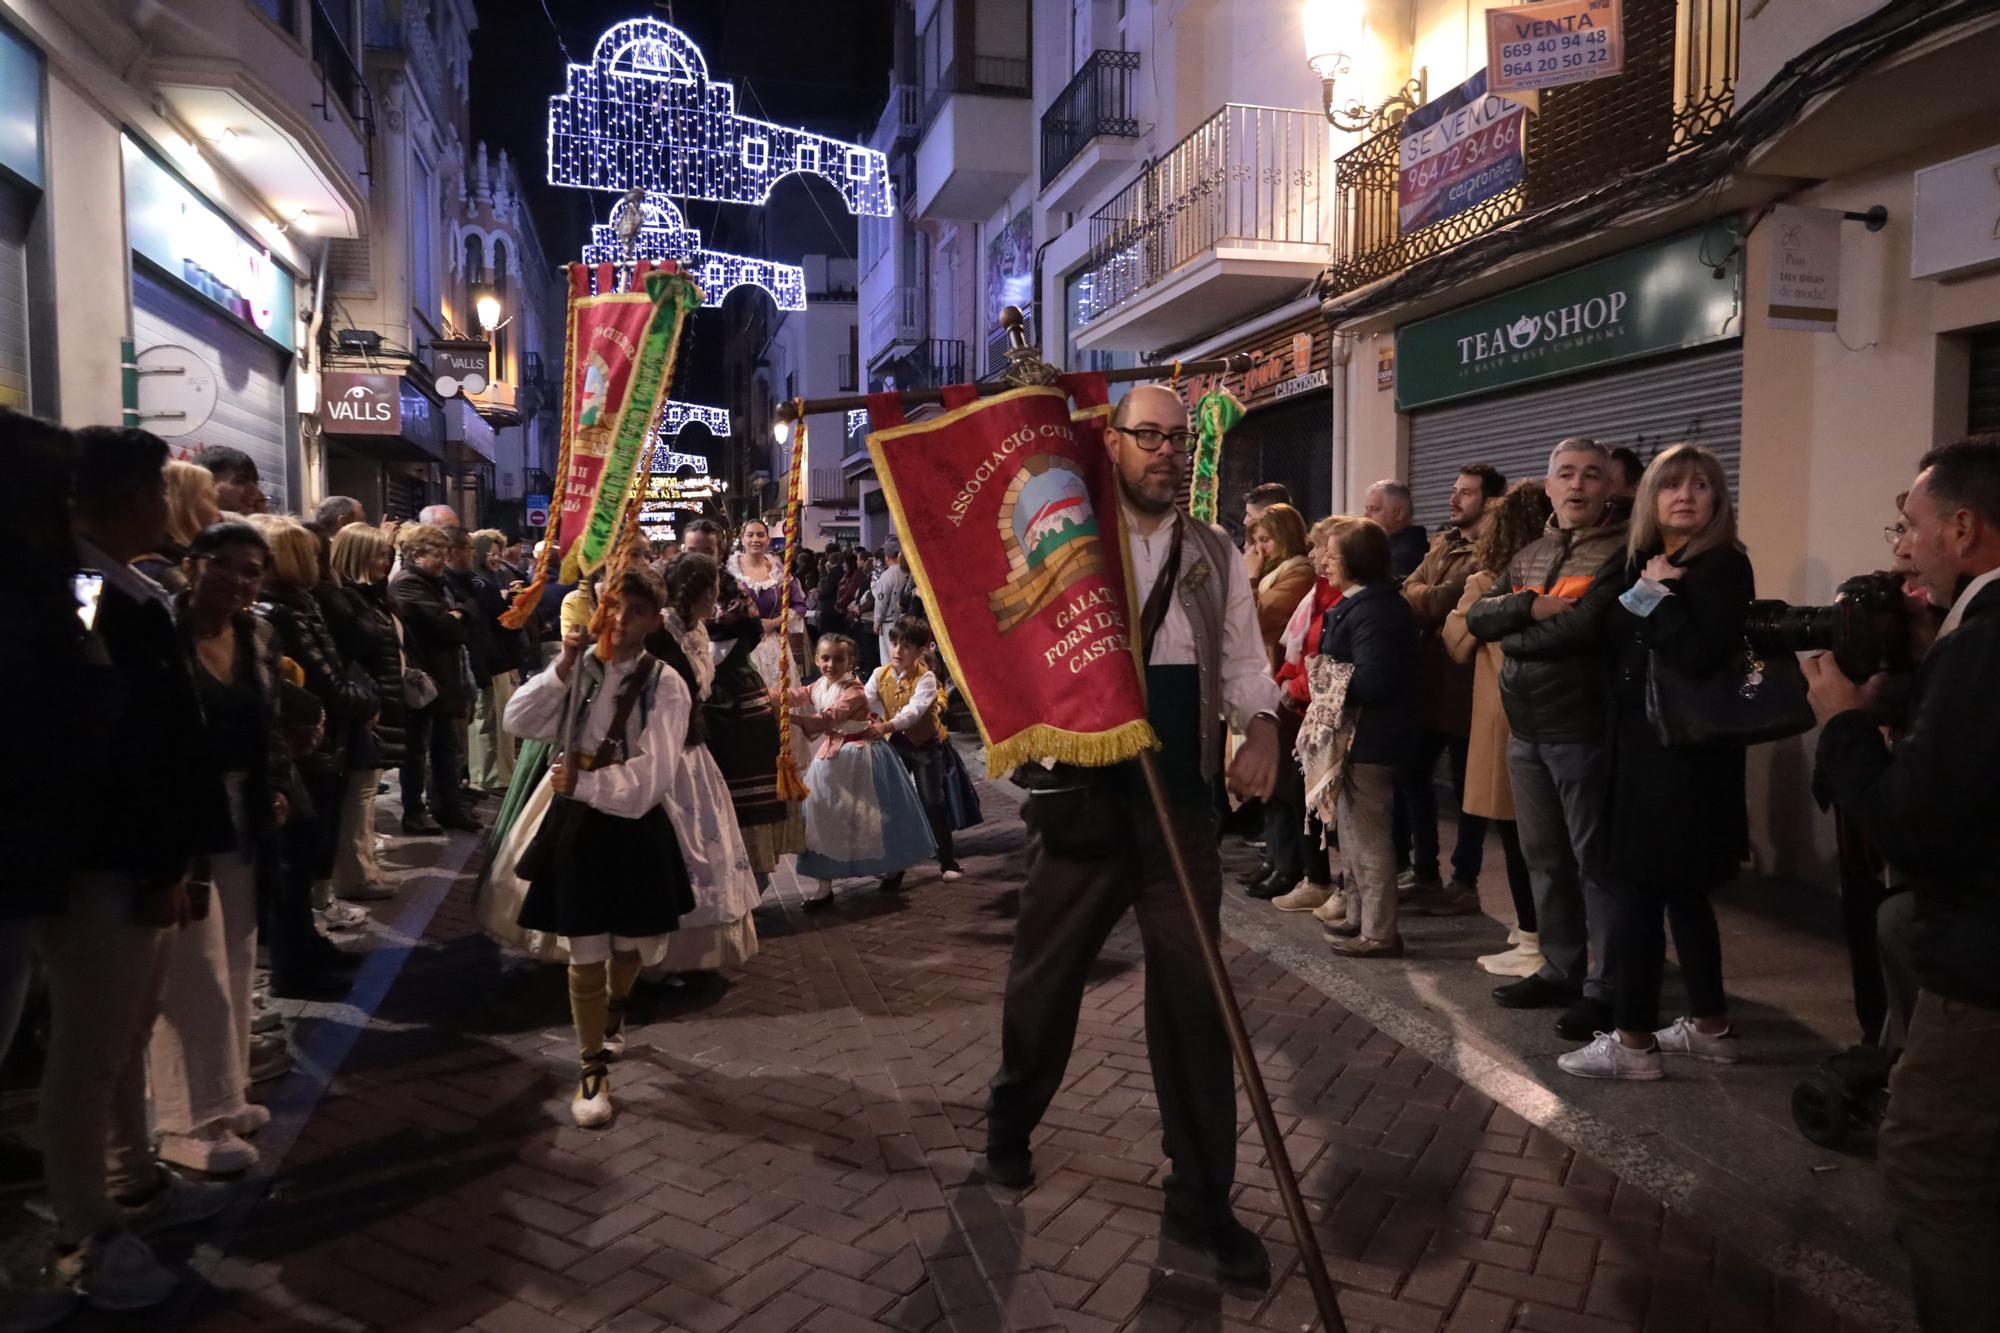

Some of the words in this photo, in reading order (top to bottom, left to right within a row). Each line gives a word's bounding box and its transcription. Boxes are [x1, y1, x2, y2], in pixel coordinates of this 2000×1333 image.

[1515, 12, 1594, 39] VENTA
[1503, 43, 1532, 59] 669
[1537, 39, 1556, 53] 40
[1561, 34, 1581, 49] 94
[1586, 29, 1607, 43] 48
[1503, 62, 1532, 77] 964
[1538, 57, 1557, 72] 20
[1562, 52, 1582, 68] 50
[1587, 48, 1607, 63] 22
[1408, 130, 1432, 161] SE
[1408, 164, 1437, 192] 964
[1492, 118, 1514, 150] 66
[1457, 327, 1506, 364] TEA
[1543, 291, 1627, 341] SHOP
[450, 358, 485, 370] VALLS
[327, 400, 392, 421] VALLS
[947, 424, 1036, 527] ASSOCIACIÓ
[1043, 618, 1094, 668] FORN
